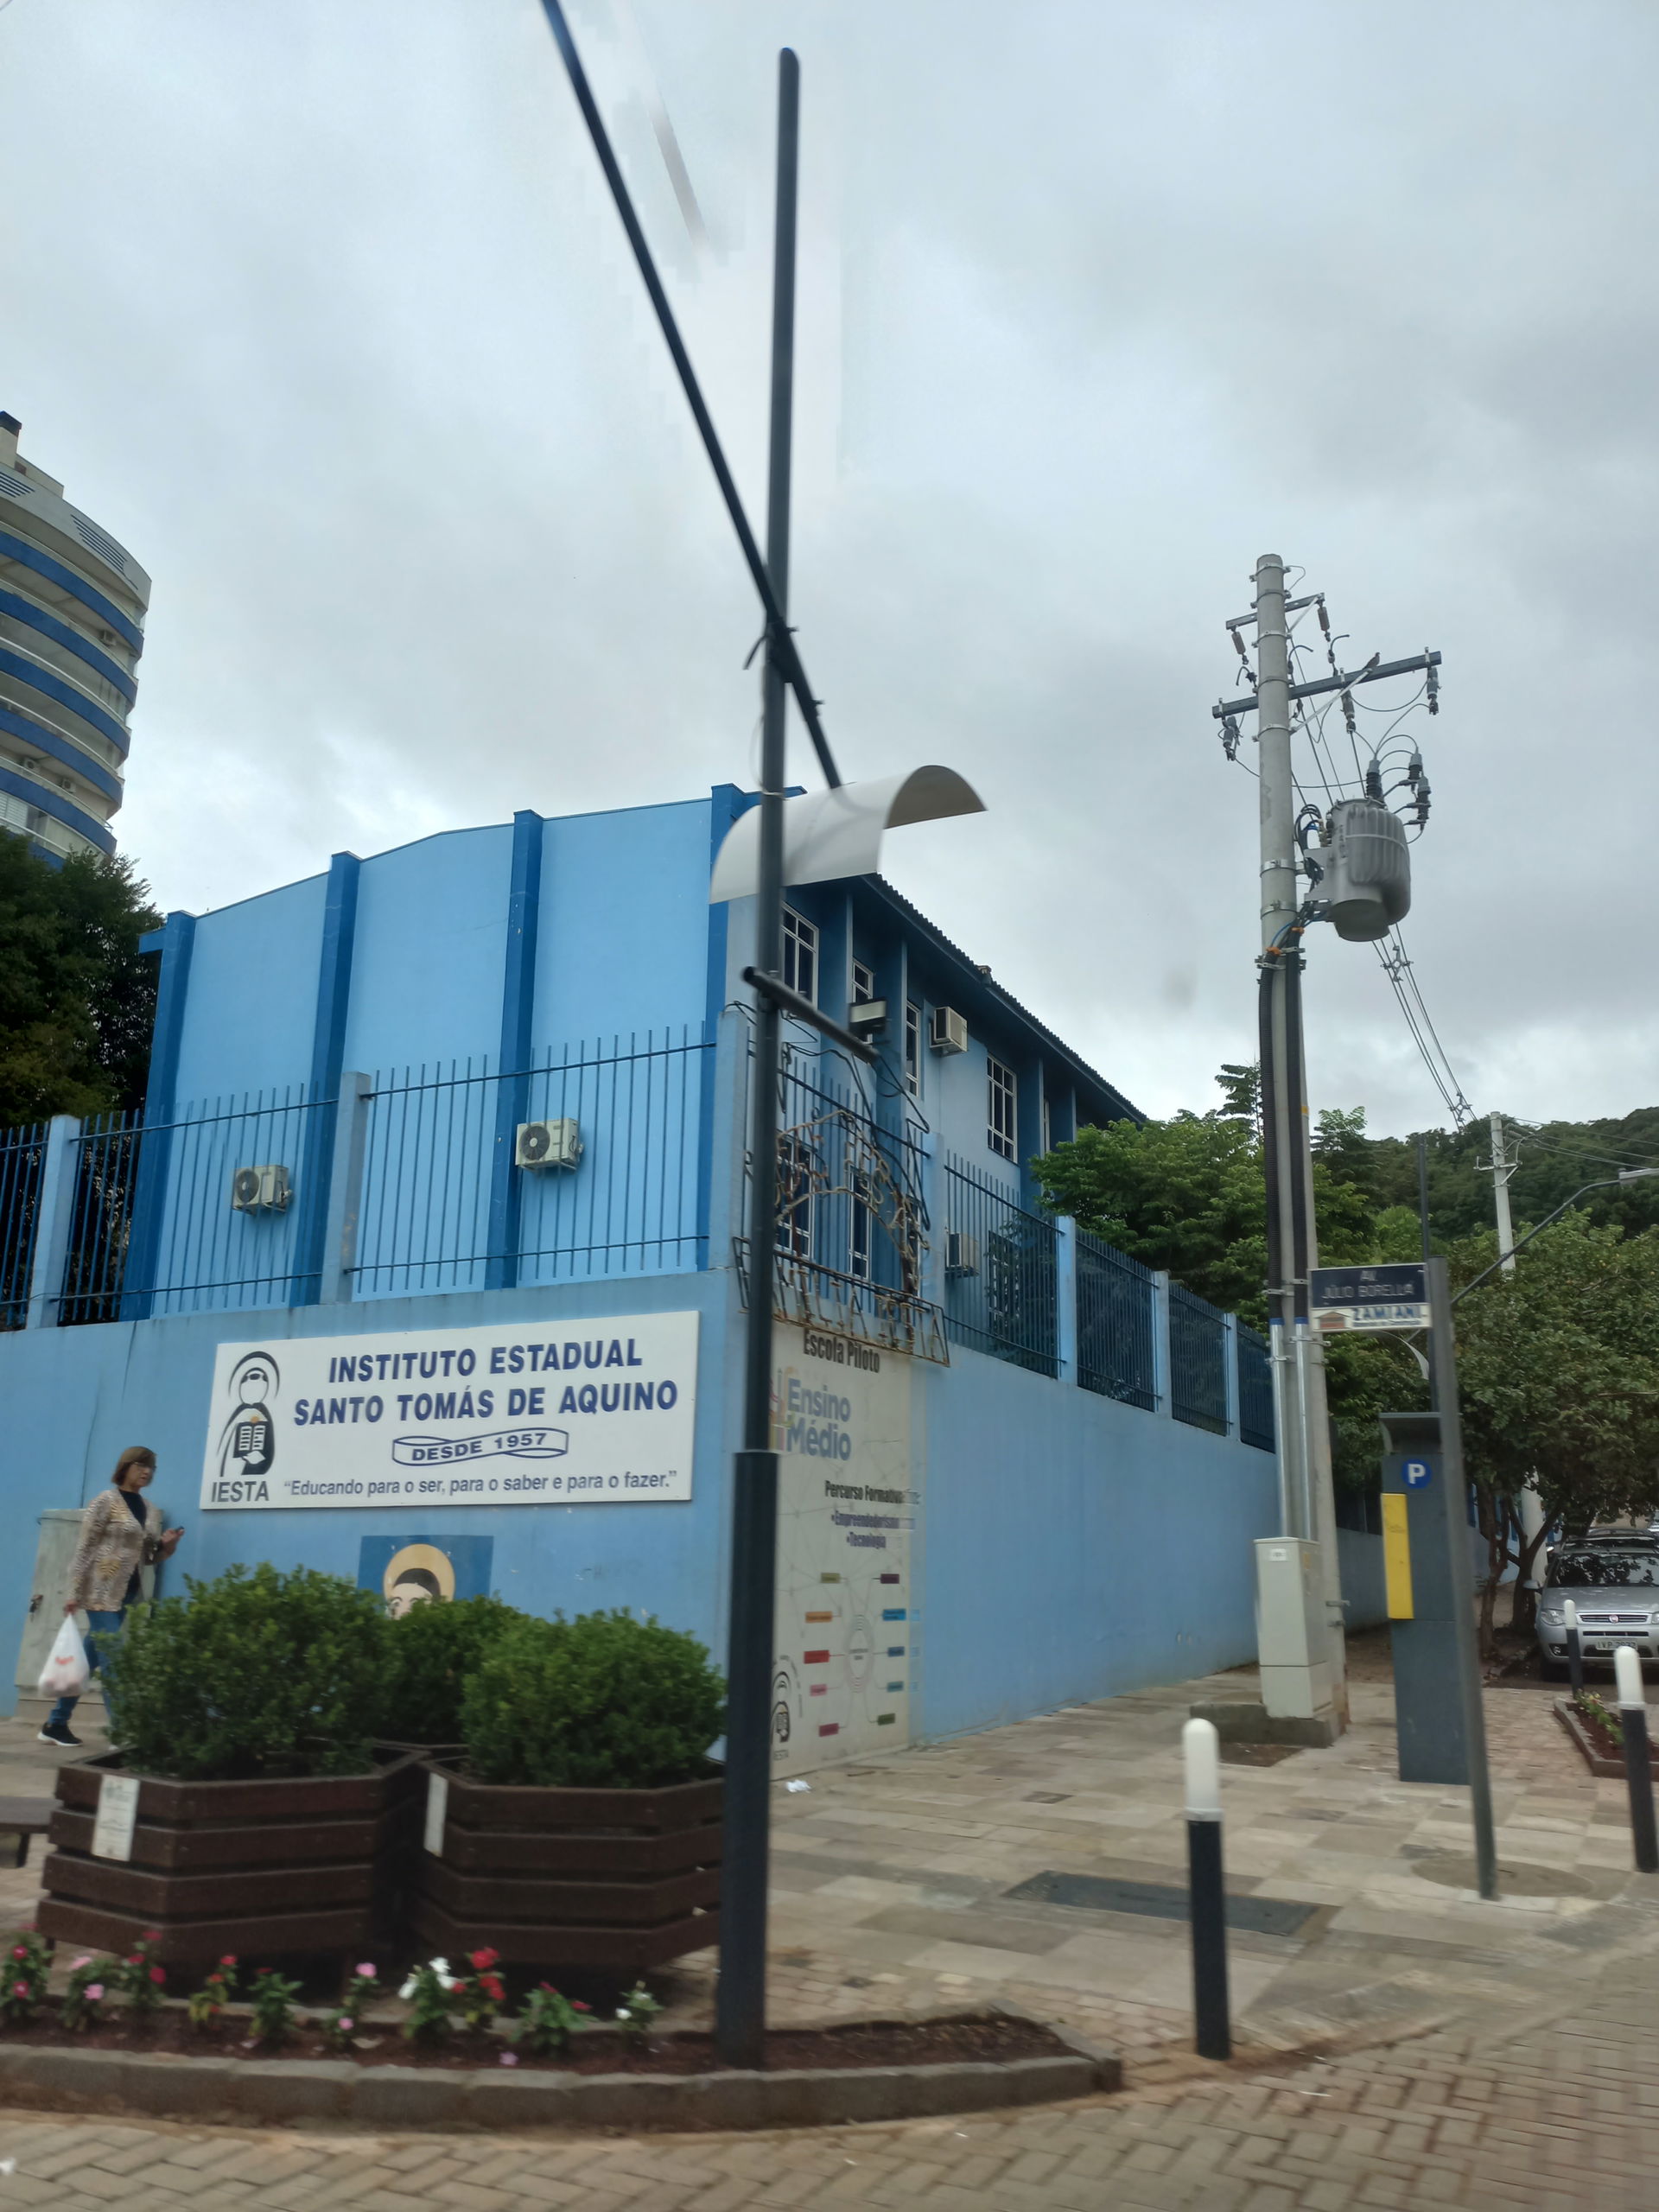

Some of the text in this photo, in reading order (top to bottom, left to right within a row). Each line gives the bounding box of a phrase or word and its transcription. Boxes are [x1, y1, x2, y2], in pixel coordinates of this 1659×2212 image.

[328, 1338, 642, 1382] INSTITUTO ESTADUAL
[803, 1330, 880, 1374] Escola Piloto
[294, 1380, 677, 1426] SANTO TOMÁS DE AQUINO
[787, 1377, 851, 1422] Ensino
[411, 1433, 547, 1461] DESDE 1957
[786, 1416, 852, 1461] Médio
[211, 1480, 270, 1503] IESTA
[367, 1481, 400, 1497] para
[404, 1481, 414, 1493] o
[418, 1480, 446, 1495] ser,
[448, 1478, 484, 1497] para
[487, 1478, 499, 1491] o
[502, 1474, 549, 1491] saber
[552, 1477, 563, 1490] e
[566, 1476, 603, 1493] para
[607, 1475, 619, 1488] o
[1407, 1463, 1427, 1484] P
